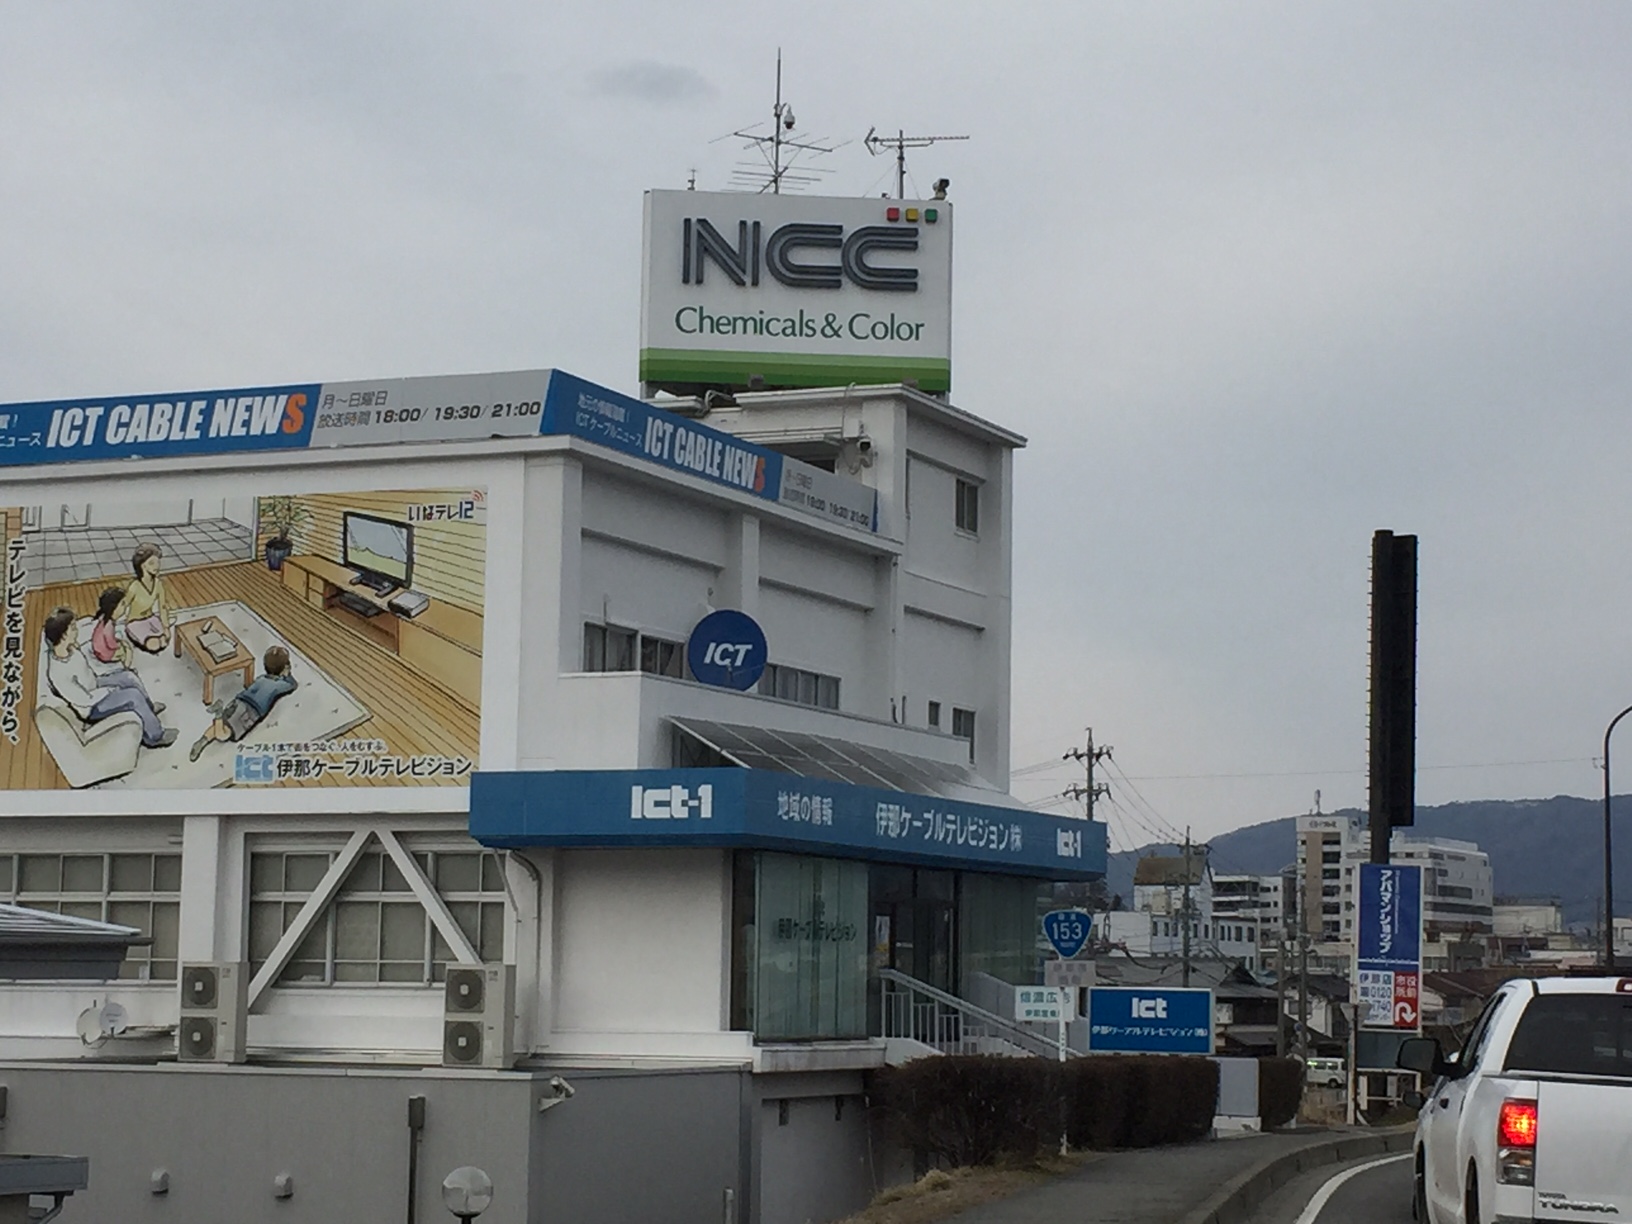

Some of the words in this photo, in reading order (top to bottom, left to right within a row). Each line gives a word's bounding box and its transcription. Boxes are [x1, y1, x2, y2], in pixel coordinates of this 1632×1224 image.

[682, 217, 918, 292] NCC
[674, 305, 816, 338] Chemicals
[820, 312, 842, 339] &
[848, 312, 925, 342] Color
[46, 406, 104, 448] ICT
[105, 400, 207, 445] CABLE
[209, 392, 307, 438] NEWS
[491, 401, 541, 418] 21:00
[645, 416, 675, 460] ICT
[674, 426, 722, 478] CABLE
[722, 443, 766, 493] NEWS
[2, 540, 26, 744] テレビを見ながら、
[703, 642, 753, 668] ICT
[277, 756, 473, 778] 伊那ケーブルテレビジョン
[777, 790, 833, 826] 地域の情報
[1380, 869, 1393, 954] アパマンショップ
[1052, 922, 1082, 940] 153
